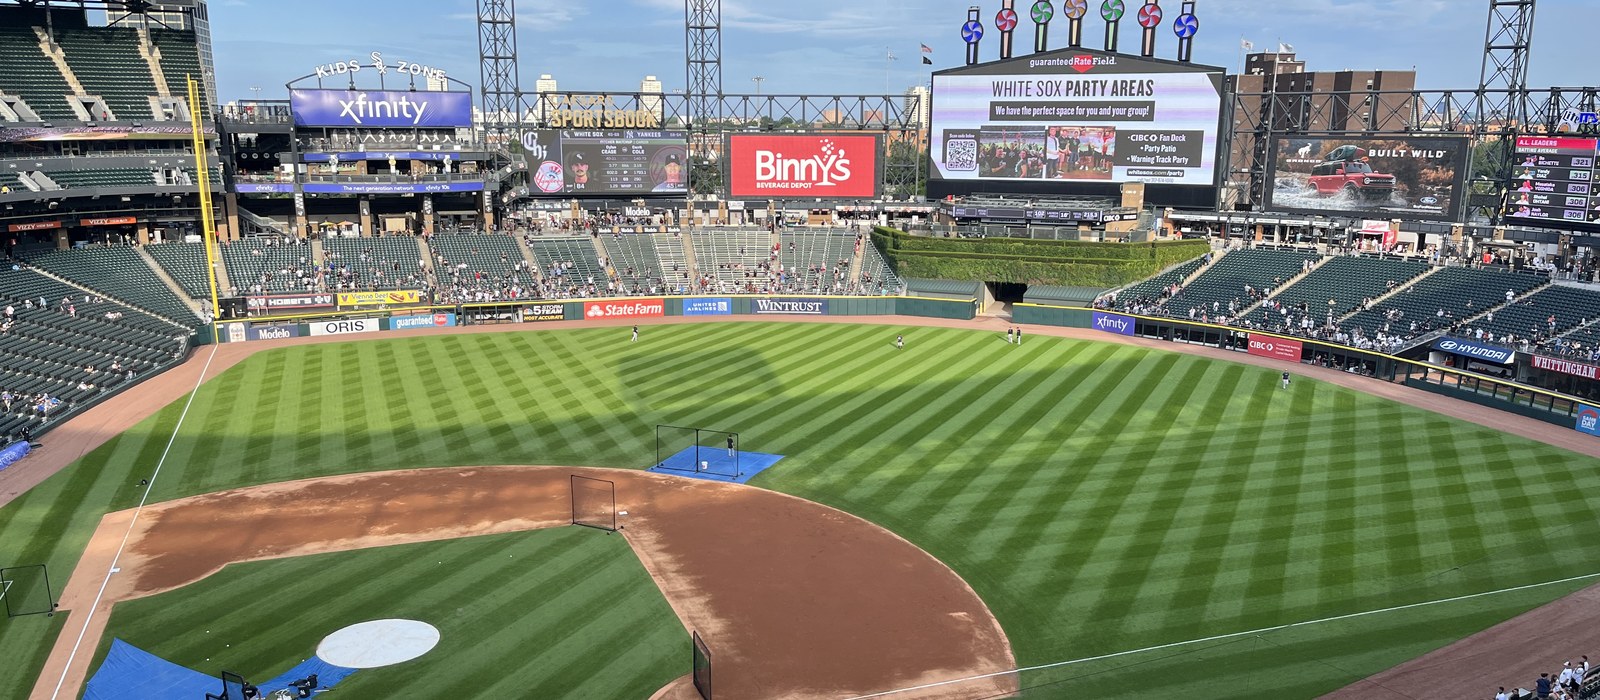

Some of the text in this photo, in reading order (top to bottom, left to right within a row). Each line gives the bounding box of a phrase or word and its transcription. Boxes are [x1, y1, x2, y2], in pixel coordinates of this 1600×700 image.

[1030, 58, 1073, 67] guaranteed
[316, 60, 361, 78] KIDS
[397, 61, 446, 82] ZONE
[992, 79, 1154, 97] WHITE SOX PARTY AREAS
[339, 94, 428, 124] xfinity
[995, 106, 1149, 117] We have the perfect space for you and your group!
[552, 110, 657, 128] SPORTSBOOK
[1563, 110, 1579, 123] Lite
[1144, 145, 1160, 153] Party
[1412, 150, 1444, 158] WILD
[1130, 155, 1155, 164] Warning
[1172, 156, 1189, 164] Party
[756, 149, 850, 186] Binny's
[626, 207, 650, 216] Modelo
[533, 306, 541, 314] 5
[757, 300, 822, 311] WINTRUST
[326, 321, 364, 333] ORIS
[396, 316, 433, 328] guaranteed
[1097, 317, 1128, 331] xfinity
[259, 329, 290, 339] Modelo
[1249, 341, 1266, 350] CIBC
[1458, 344, 1507, 359] HYUNDAI
[1534, 357, 1596, 377] WHITTINGHAM
[1582, 420, 1596, 428] DAY
